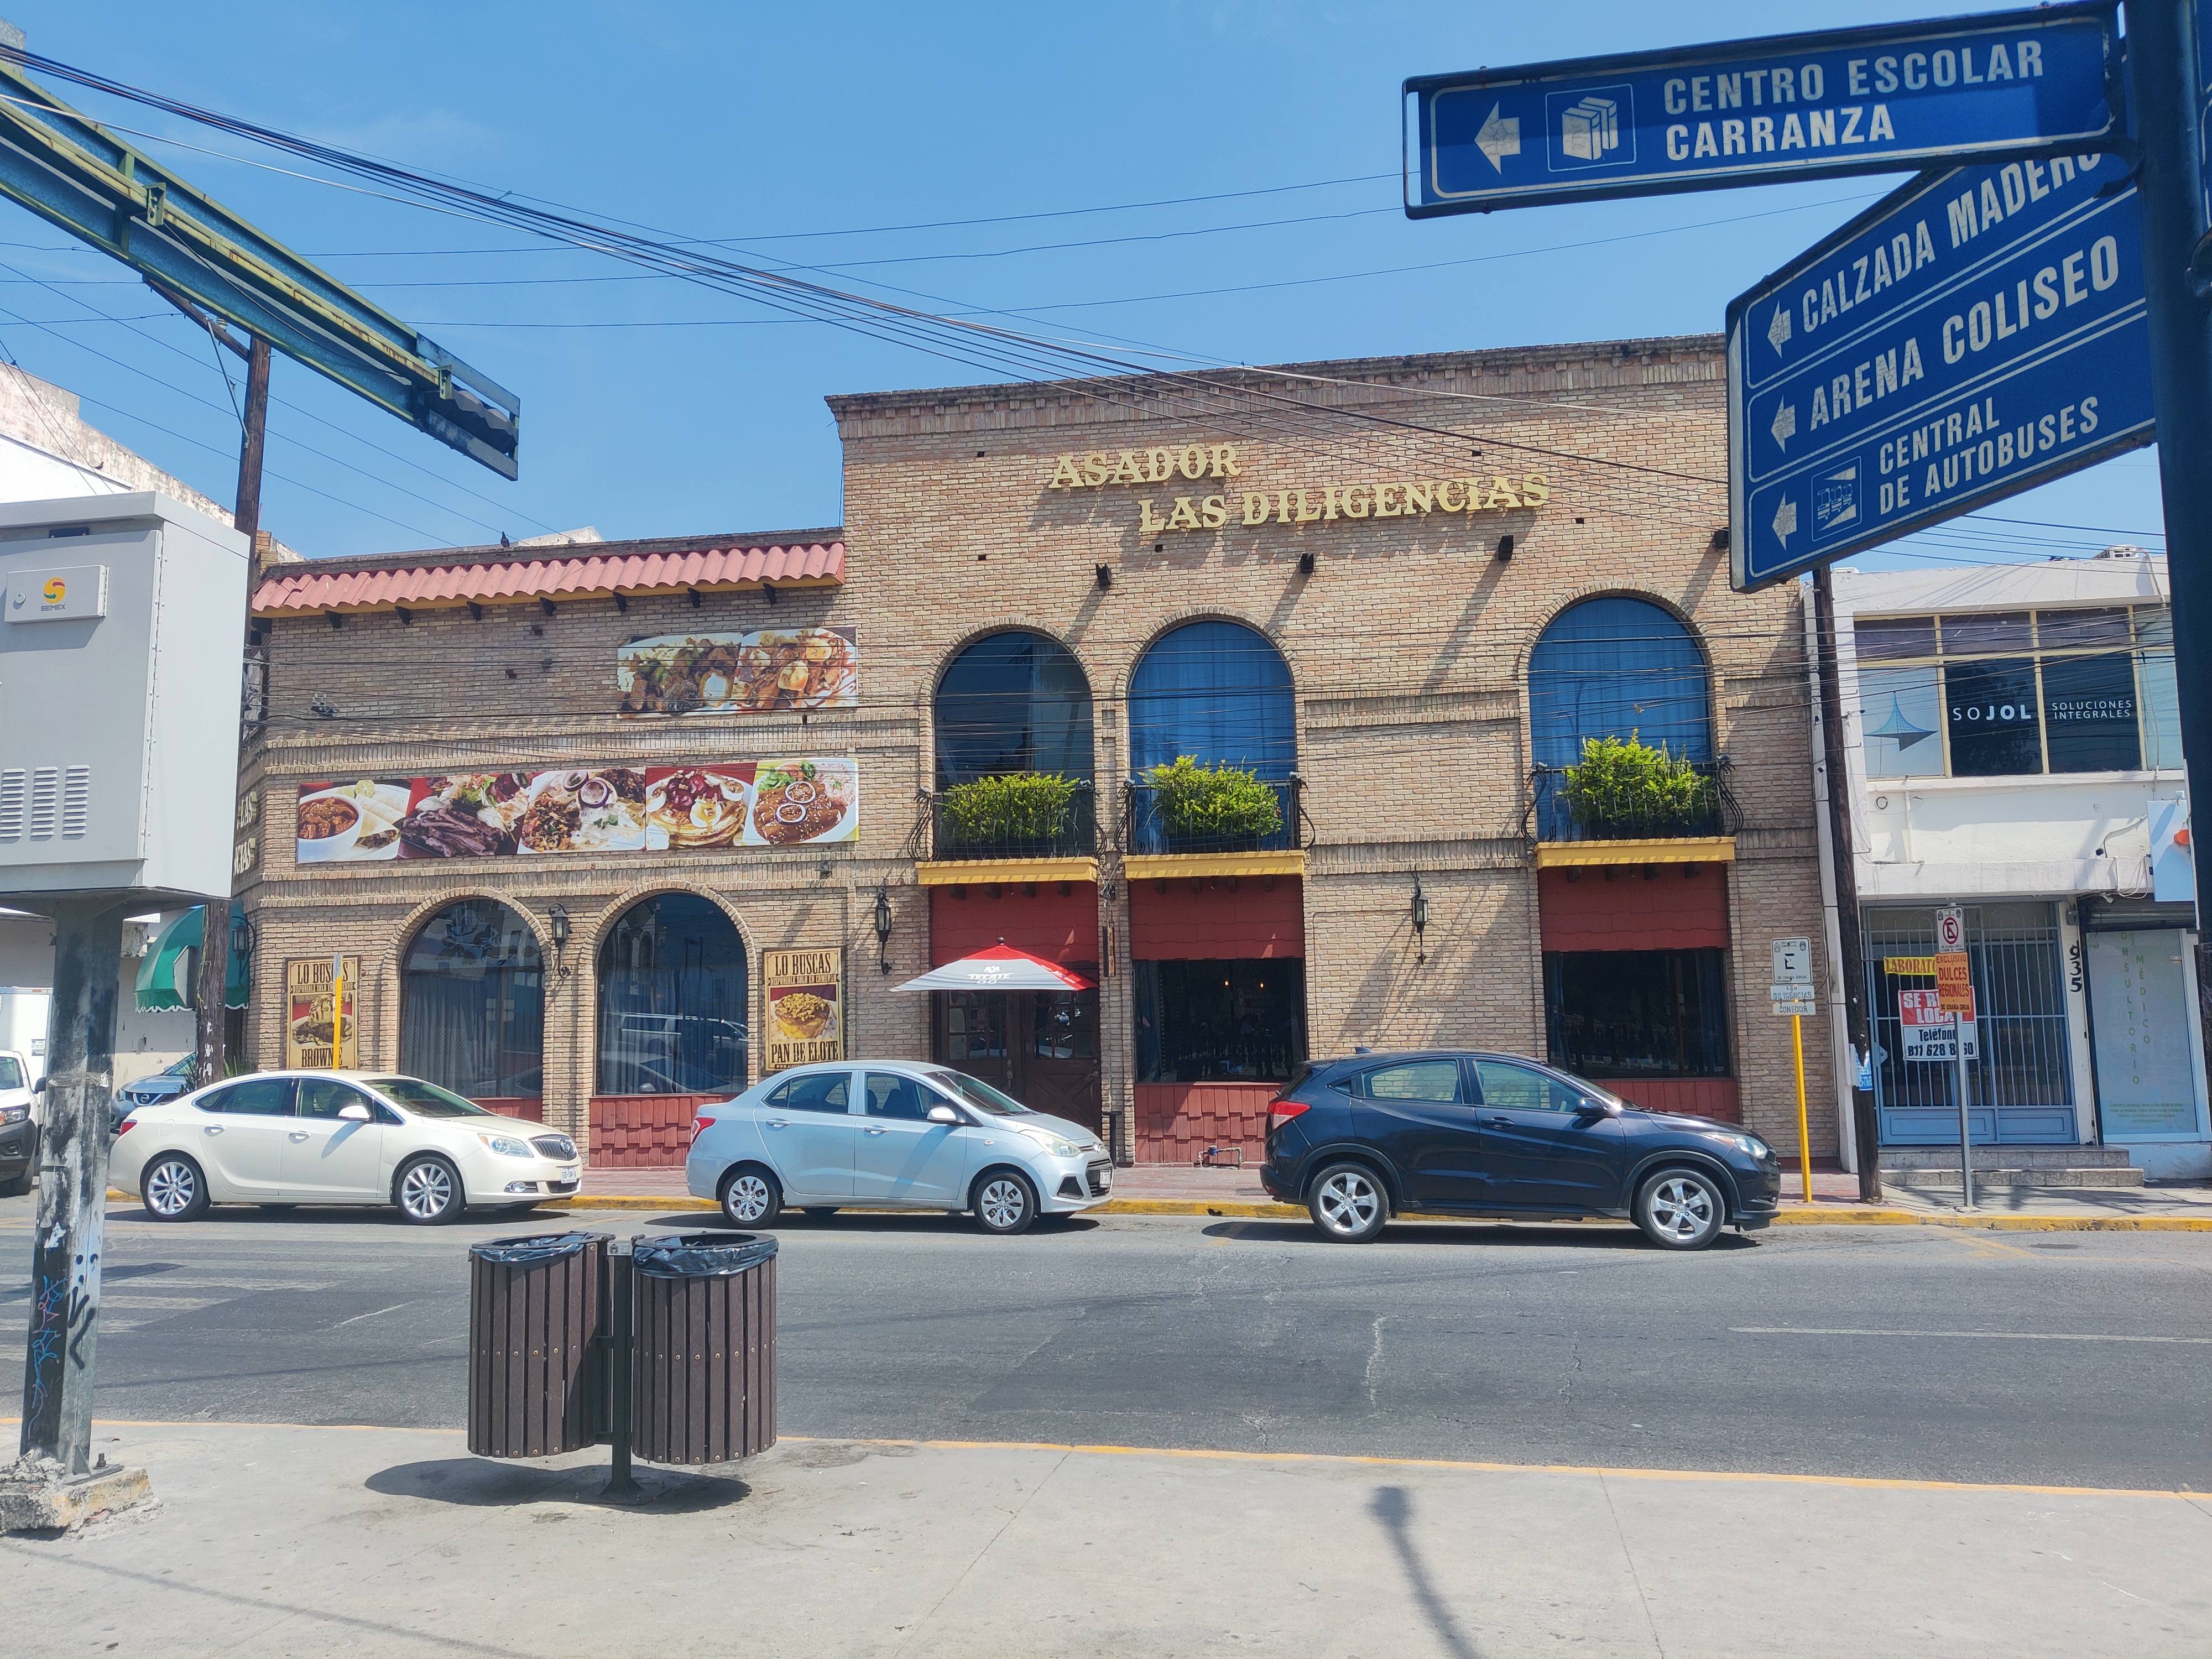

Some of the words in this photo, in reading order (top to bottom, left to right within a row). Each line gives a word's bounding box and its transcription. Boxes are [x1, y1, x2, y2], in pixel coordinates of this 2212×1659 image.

[1665, 59, 1824, 116] CENTRO
[1849, 40, 2044, 97] ESCOLAR
[1665, 103, 1895, 163] CARRANZA
[1802, 238, 1935, 334] CALZADA
[1809, 336, 1924, 432] ARENA
[1942, 234, 2121, 367] COLISEO
[1879, 397, 2000, 475] CENTRAL
[1049, 443, 1242, 489] ASADOR
[1879, 479, 1912, 515] DE
[1924, 396, 2099, 498] AUTOBUSES
[1138, 494, 1227, 534] LAS
[1242, 473, 1551, 525] DILIGENCIAS
[41, 603, 66, 612] SEMEX
[1953, 704, 2032, 721] SOJOL
[2052, 700, 2132, 711] SOLUCIONES
[2054, 709, 2131, 720] INTEGRALES
[775, 955, 788, 976] LO
[792, 952, 831, 975] BUSCAS
[1936, 954, 1967, 963] EXCLUSIVO
[297, 963, 309, 984] LO
[312, 961, 348, 984] BUSS
[967, 972, 1014, 980] TECATE
[1939, 967, 1967, 980] DULCES
[1773, 992, 1812, 1000] DILIGENCIAS
[1903, 993, 1922, 1008] SE
[1938, 983, 1970, 997] REGIONALES
[2136, 954, 2151, 1044] MÉDICO
[2120, 932, 2140, 1085] ONSULTORIO
[301, 1047, 343, 1068] BROWNE
[771, 1043, 790, 1063] PAN
[792, 1042, 806, 1062] DE
[808, 1040, 838, 1061] ELOTE
[1907, 1045, 1923, 1057] 811
[1926, 1044, 1946, 1057] 628
[1949, 1042, 1974, 1056] 860
